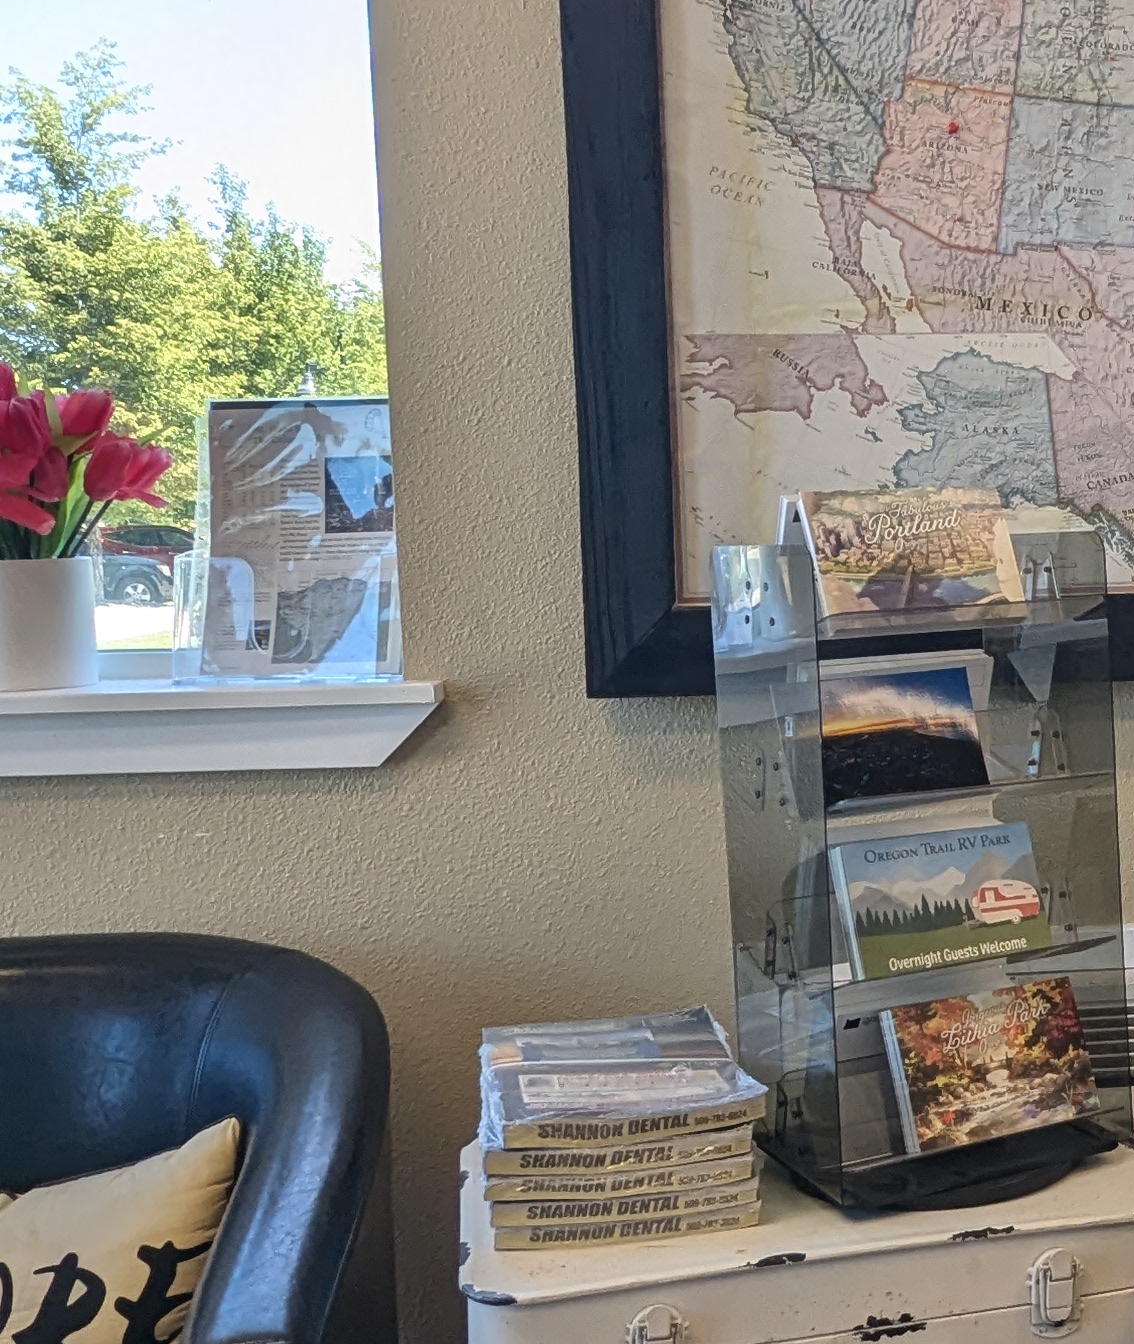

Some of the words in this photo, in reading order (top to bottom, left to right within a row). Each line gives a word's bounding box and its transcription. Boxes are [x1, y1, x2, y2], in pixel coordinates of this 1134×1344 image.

[923, 141, 968, 153] ARIZONA
[709, 166, 776, 192] PACIFIC
[1063, 185, 1103, 196] MEXICO
[710, 185, 763, 206] OCEAN
[812, 262, 876, 280] CALIFORNIA
[832, 257, 860, 267] BAJA
[975, 296, 1093, 321] MEXICO
[771, 348, 812, 379] RUSSIA
[962, 423, 1020, 435] ALASKA
[889, 500, 946, 518] Fabulous
[865, 509, 960, 544] Portland
[863, 846, 918, 864] OREGON
[957, 836, 979, 852] RV
[888, 951, 943, 972] Overnight
[943, 944, 979, 963] Guests
[979, 936, 1028, 956] Welcome
[941, 1022, 1000, 1053] Lithia
[1004, 999, 1051, 1028] Park
[538, 1121, 624, 1141] SHANNON
[628, 1113, 690, 1135] DENTAL
[520, 1150, 607, 1169] SHANNON
[611, 1146, 674, 1166] DENTAL
[527, 1199, 613, 1220] SHANNON
[617, 1195, 680, 1216] DENTAL
[529, 1222, 615, 1243] SHANNON
[619, 1216, 682, 1237] DENTAL
